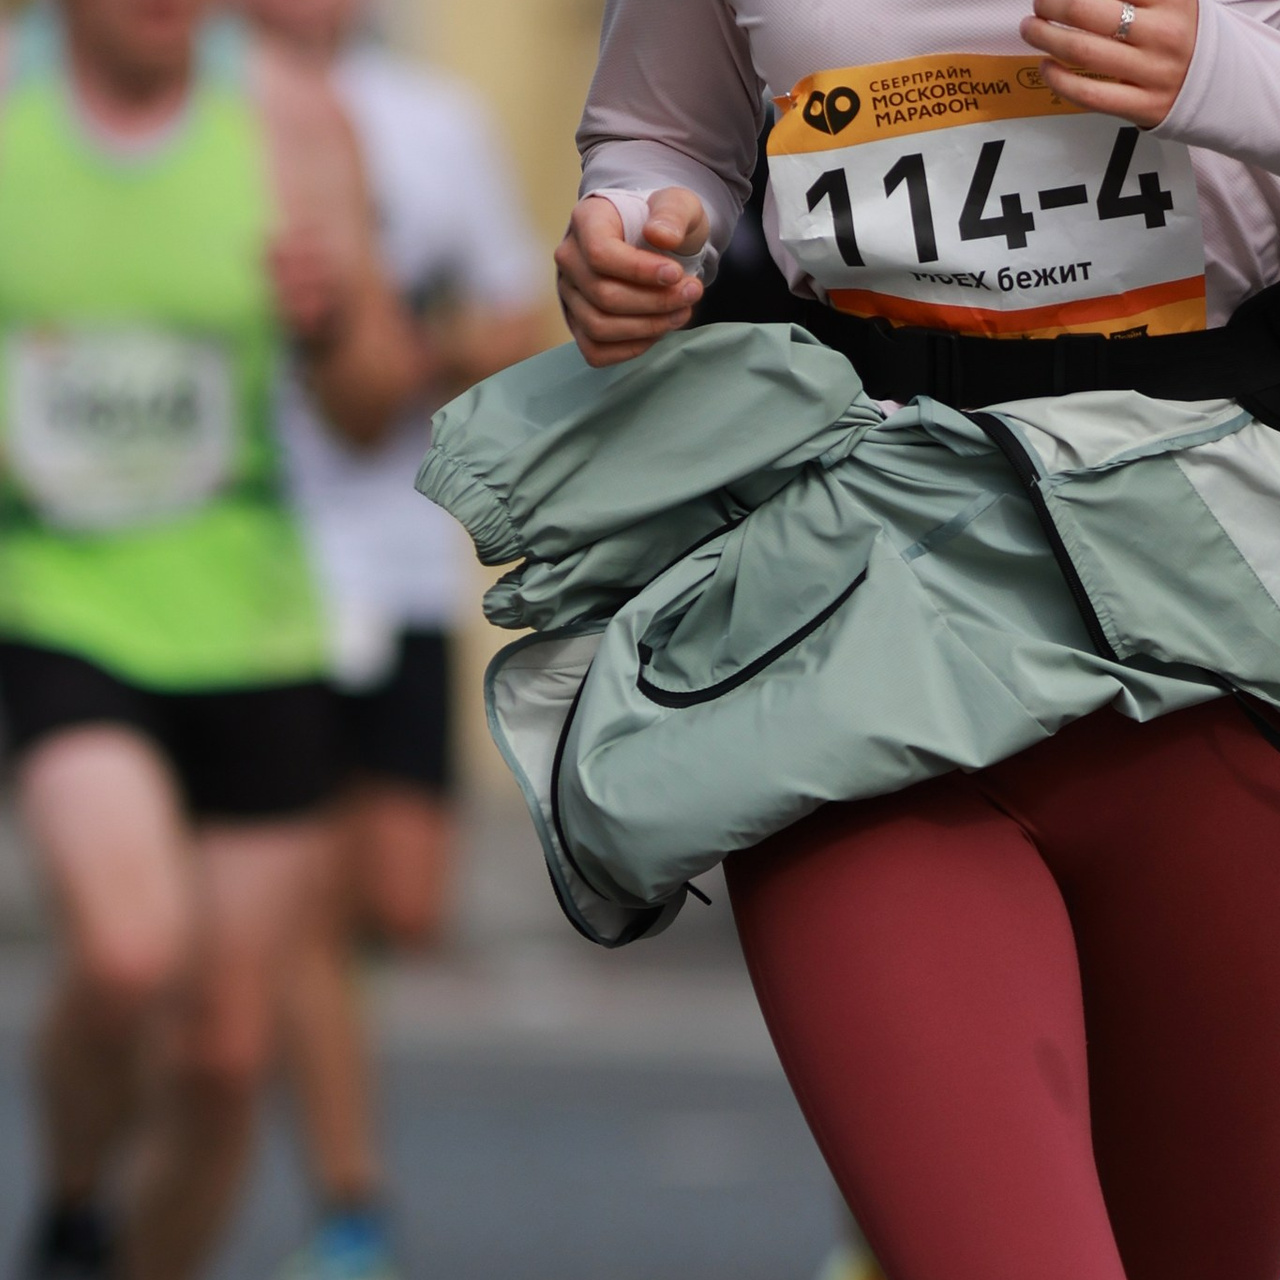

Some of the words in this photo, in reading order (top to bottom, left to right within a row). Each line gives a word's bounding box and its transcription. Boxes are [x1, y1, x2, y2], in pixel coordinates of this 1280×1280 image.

[869, 66, 971, 92] СБЕРПРАЙМ
[872, 79, 1011, 110] МОСКОВСКИЙ
[875, 97, 979, 127] МАРАФОН
[805, 126, 1174, 267] 114-4
[998, 261, 1092, 291] бежит
